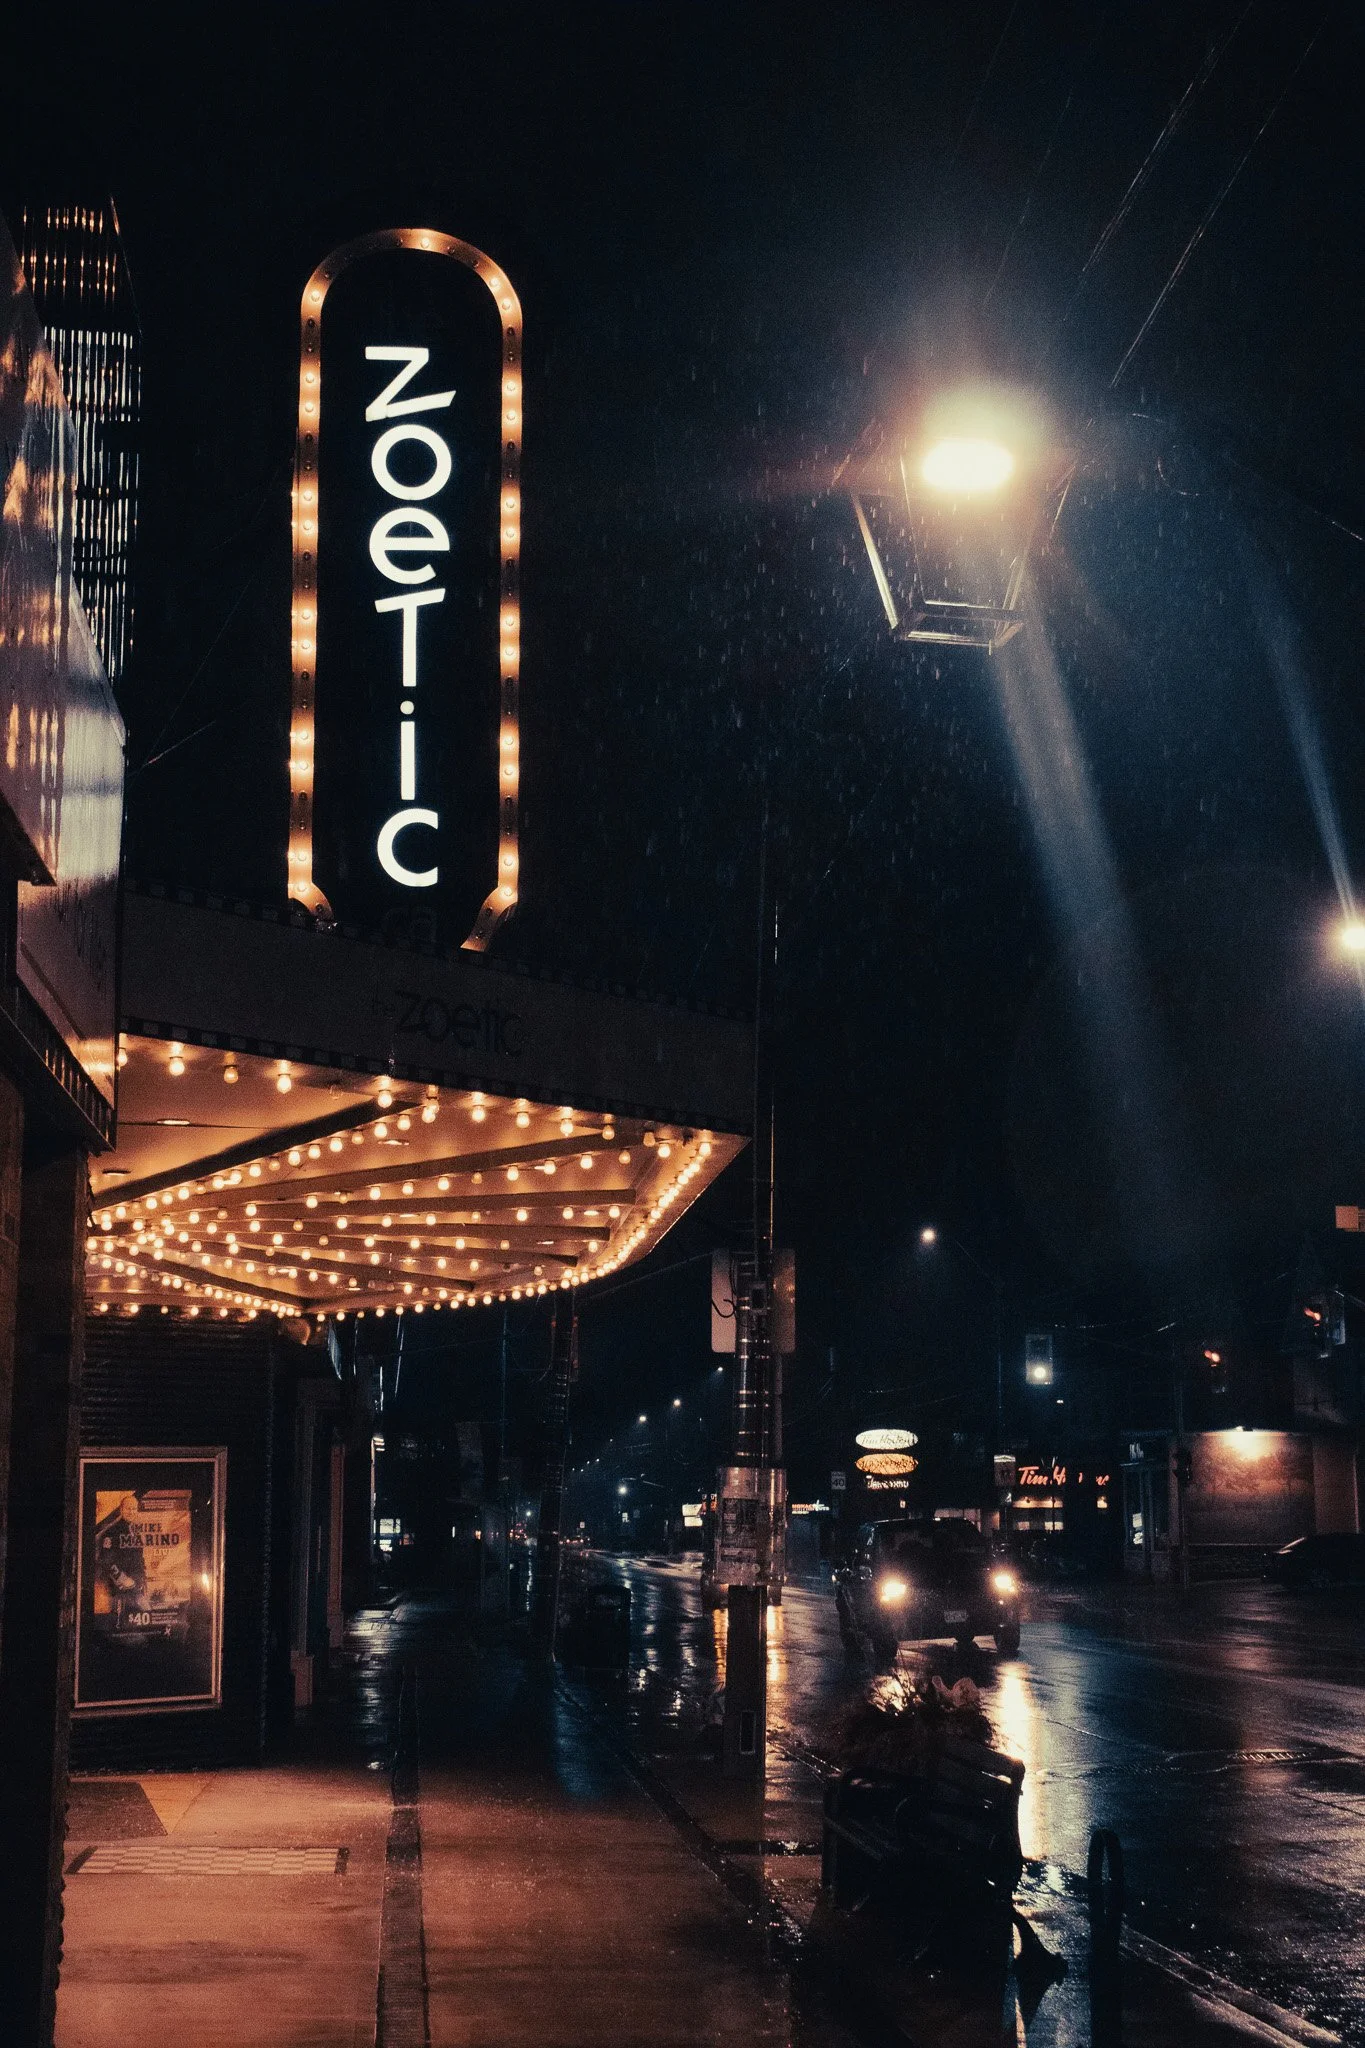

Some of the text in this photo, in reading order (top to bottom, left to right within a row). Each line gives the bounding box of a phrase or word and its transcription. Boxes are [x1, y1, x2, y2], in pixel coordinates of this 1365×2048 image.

[832, 1478, 845, 1487] 40
[1017, 1465, 1048, 1486] Tim
[132, 1522, 163, 1534] MIKE
[119, 1532, 180, 1549] MARINO
[128, 1611, 150, 1626] $40
